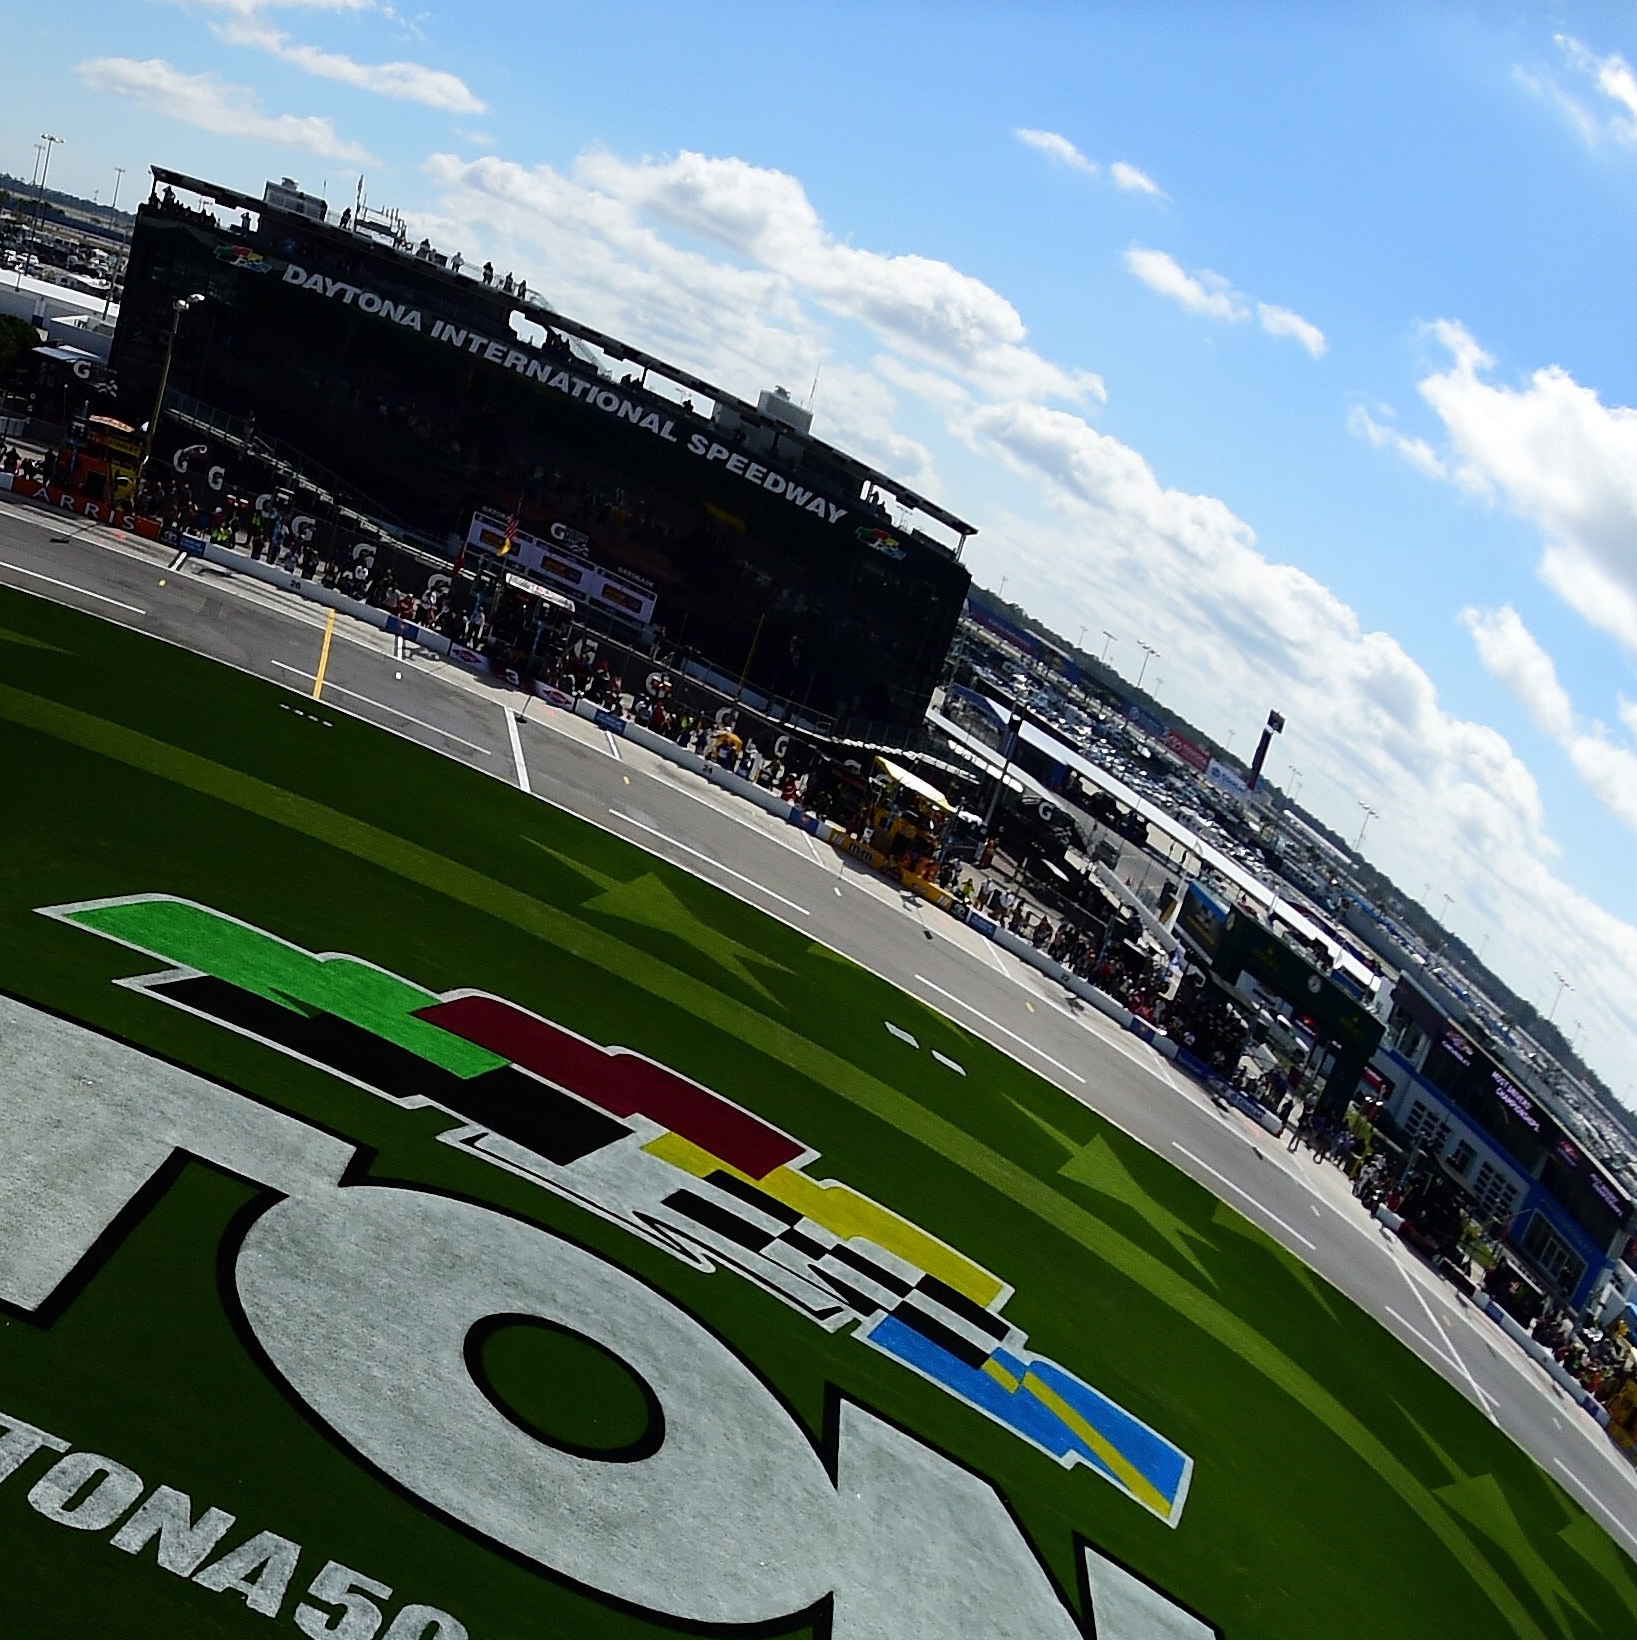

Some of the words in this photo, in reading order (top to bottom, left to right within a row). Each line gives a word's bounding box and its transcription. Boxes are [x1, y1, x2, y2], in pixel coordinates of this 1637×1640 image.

[281, 263, 424, 333] DAYTONA
[430, 319, 681, 443] INTERNATIONAL
[686, 431, 851, 526] SPEEDWAY
[208, 465, 226, 491] G
[31, 485, 137, 531] ARRIS
[504, 668, 521, 685] 3
